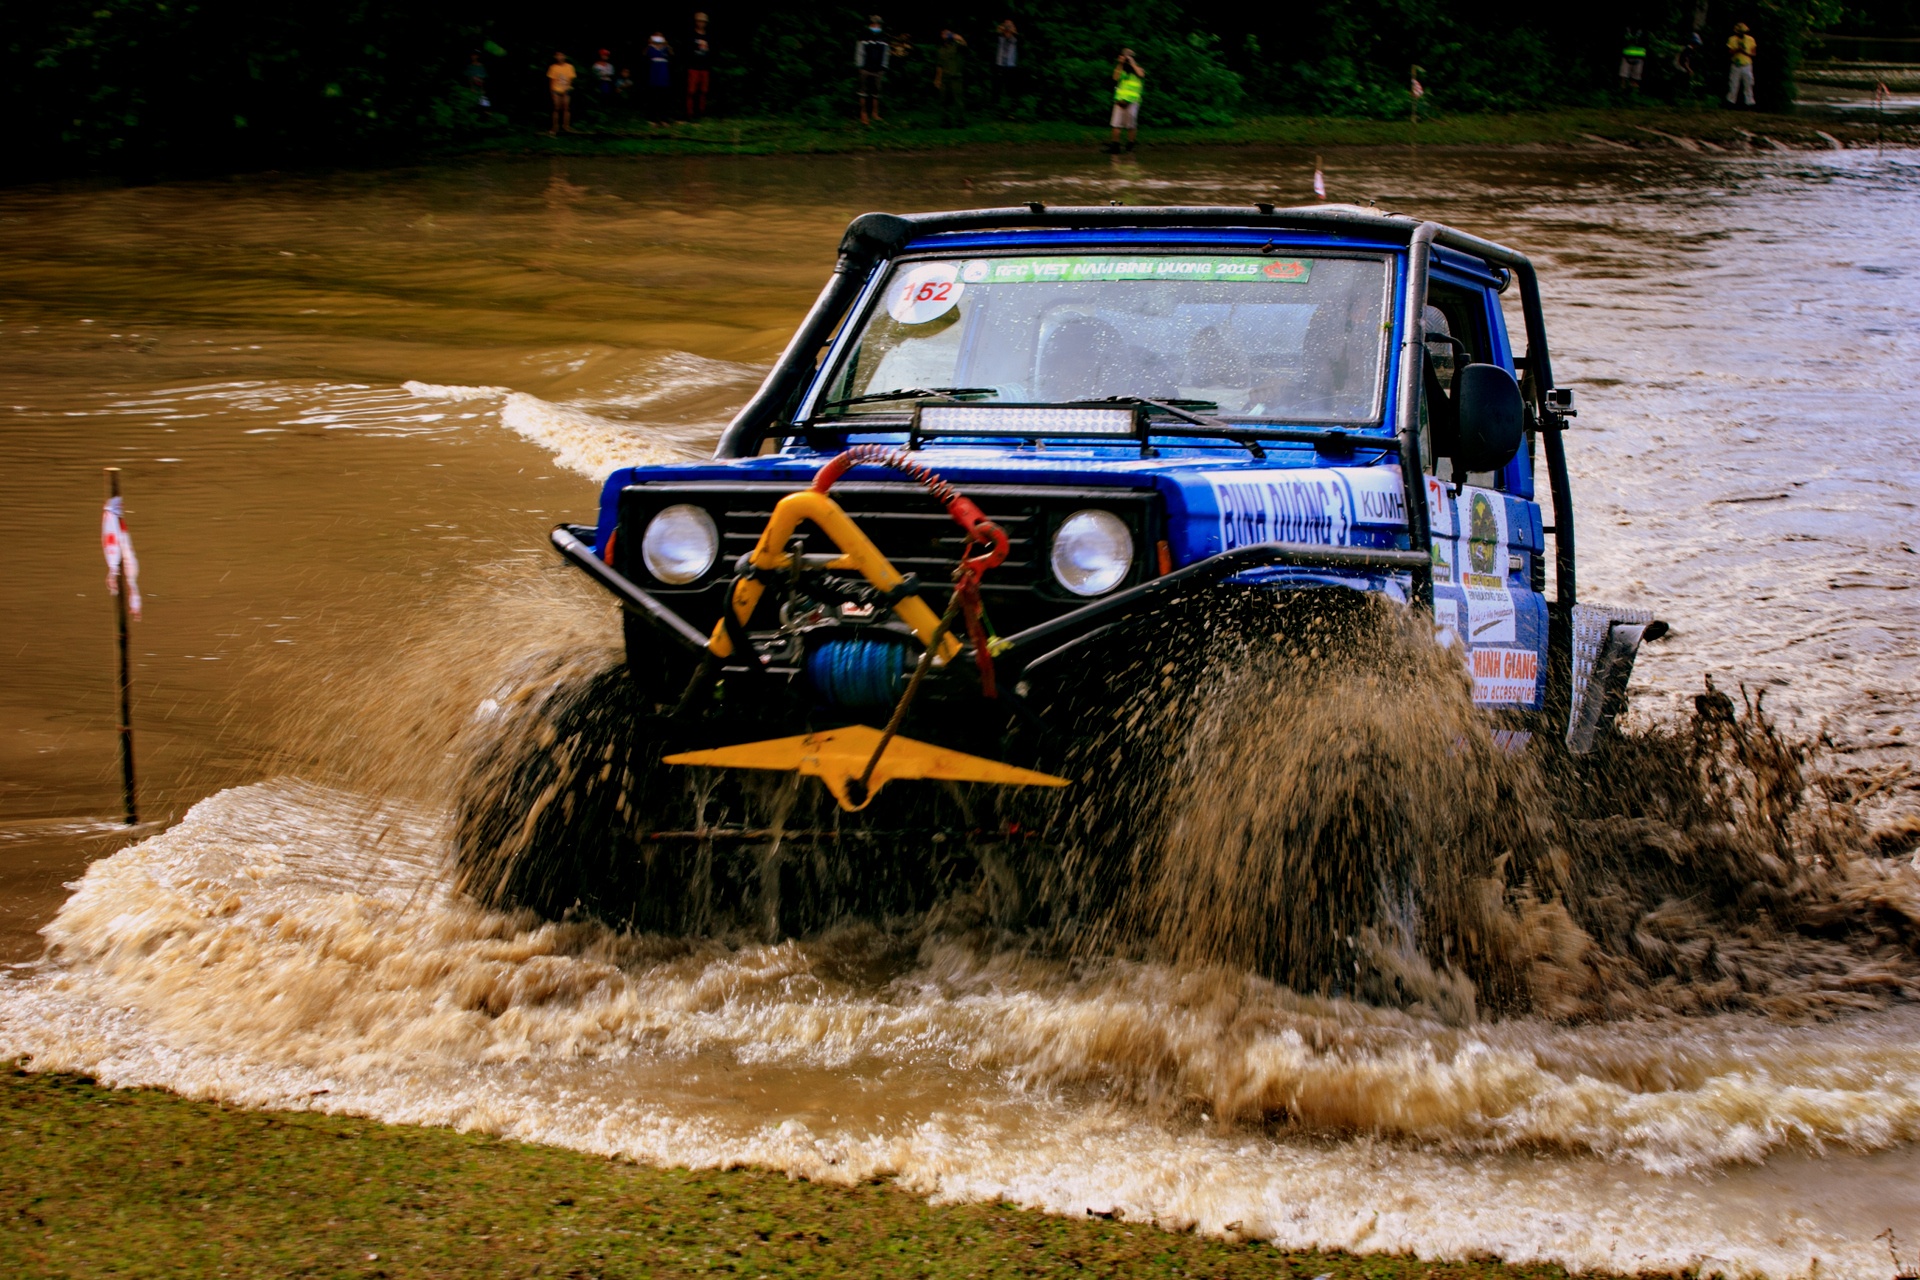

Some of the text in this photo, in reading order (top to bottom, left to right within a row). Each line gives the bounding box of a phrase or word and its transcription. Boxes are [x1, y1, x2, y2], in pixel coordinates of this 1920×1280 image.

[994, 263, 1029, 276] RFC
[1073, 262, 1115, 275] NAM
[1215, 262, 1258, 275] 2015
[903, 282, 953, 302] 152
[1473, 650, 1538, 681] MINH GIANG
